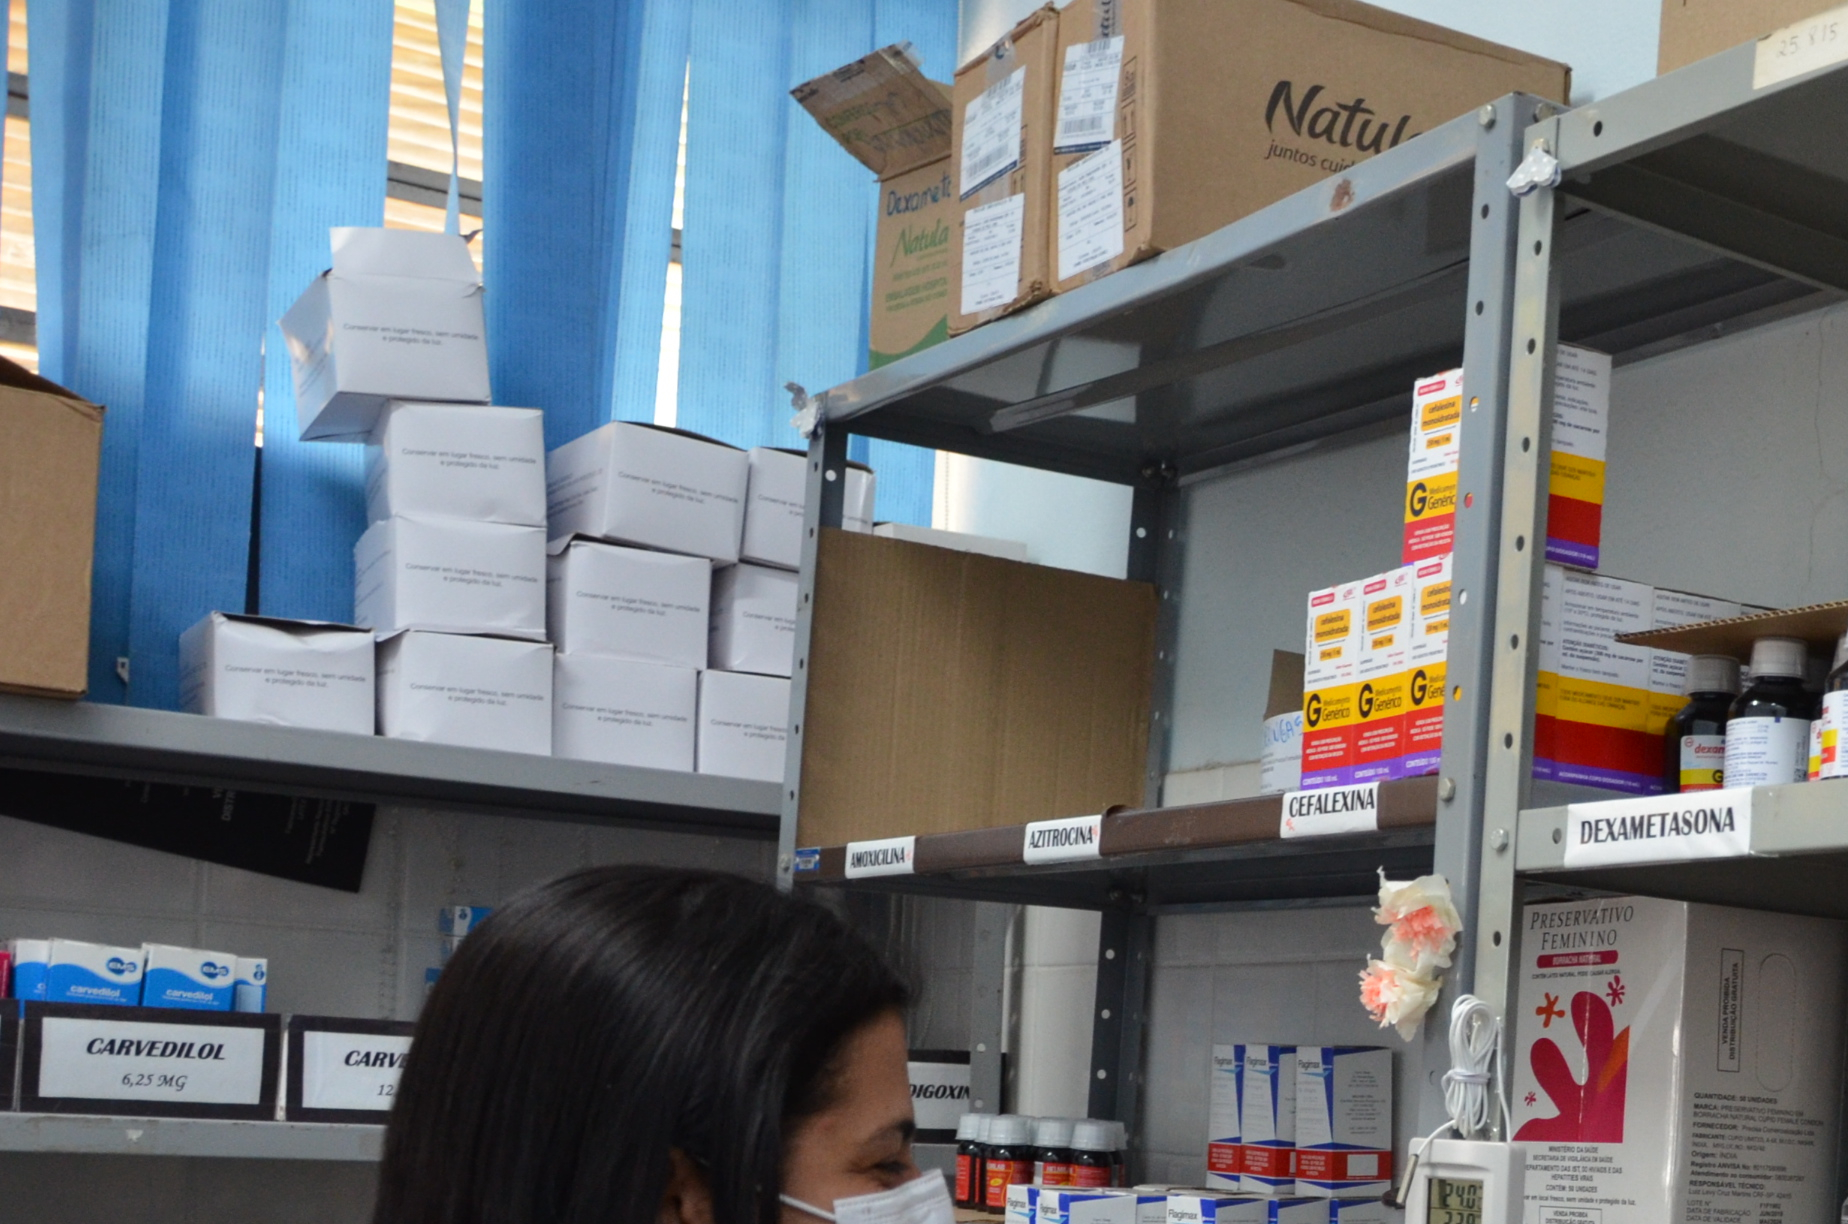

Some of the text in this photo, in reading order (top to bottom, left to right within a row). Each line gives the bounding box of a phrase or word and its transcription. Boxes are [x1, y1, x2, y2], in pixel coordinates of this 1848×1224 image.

[1265, 80, 1423, 154] Natul
[1264, 139, 1317, 167] juntos
[393, 326, 410, 336] lugar
[1410, 482, 1427, 517] G
[1411, 670, 1427, 705] G
[1307, 694, 1321, 727] G
[1359, 684, 1373, 718] G
[1374, 697, 1401, 711] Genérico
[1323, 708, 1349, 720] Genérico
[1288, 788, 1375, 818] CEFALEXINA
[1581, 807, 1735, 845] DEXAMETASONA
[1028, 826, 1093, 849] AZITROCINA
[850, 846, 905, 869] AMOXICILINA
[1530, 906, 1633, 929] PRESERVATIVO
[1542, 930, 1617, 950] FEMININO
[108, 961, 137, 974] EMS
[202, 965, 229, 977] EMS
[70, 984, 120, 997] carvedilol
[166, 988, 213, 1000] carvedilol
[1729, 1003, 1737, 1060] DISTRIBUIÇÃO
[87, 1038, 225, 1060] CARVEDILOL
[122, 1074, 188, 1091] 6,25 MG
[377, 1084, 394, 1096] 12
[1168, 1209, 1198, 1221] Flagimax
